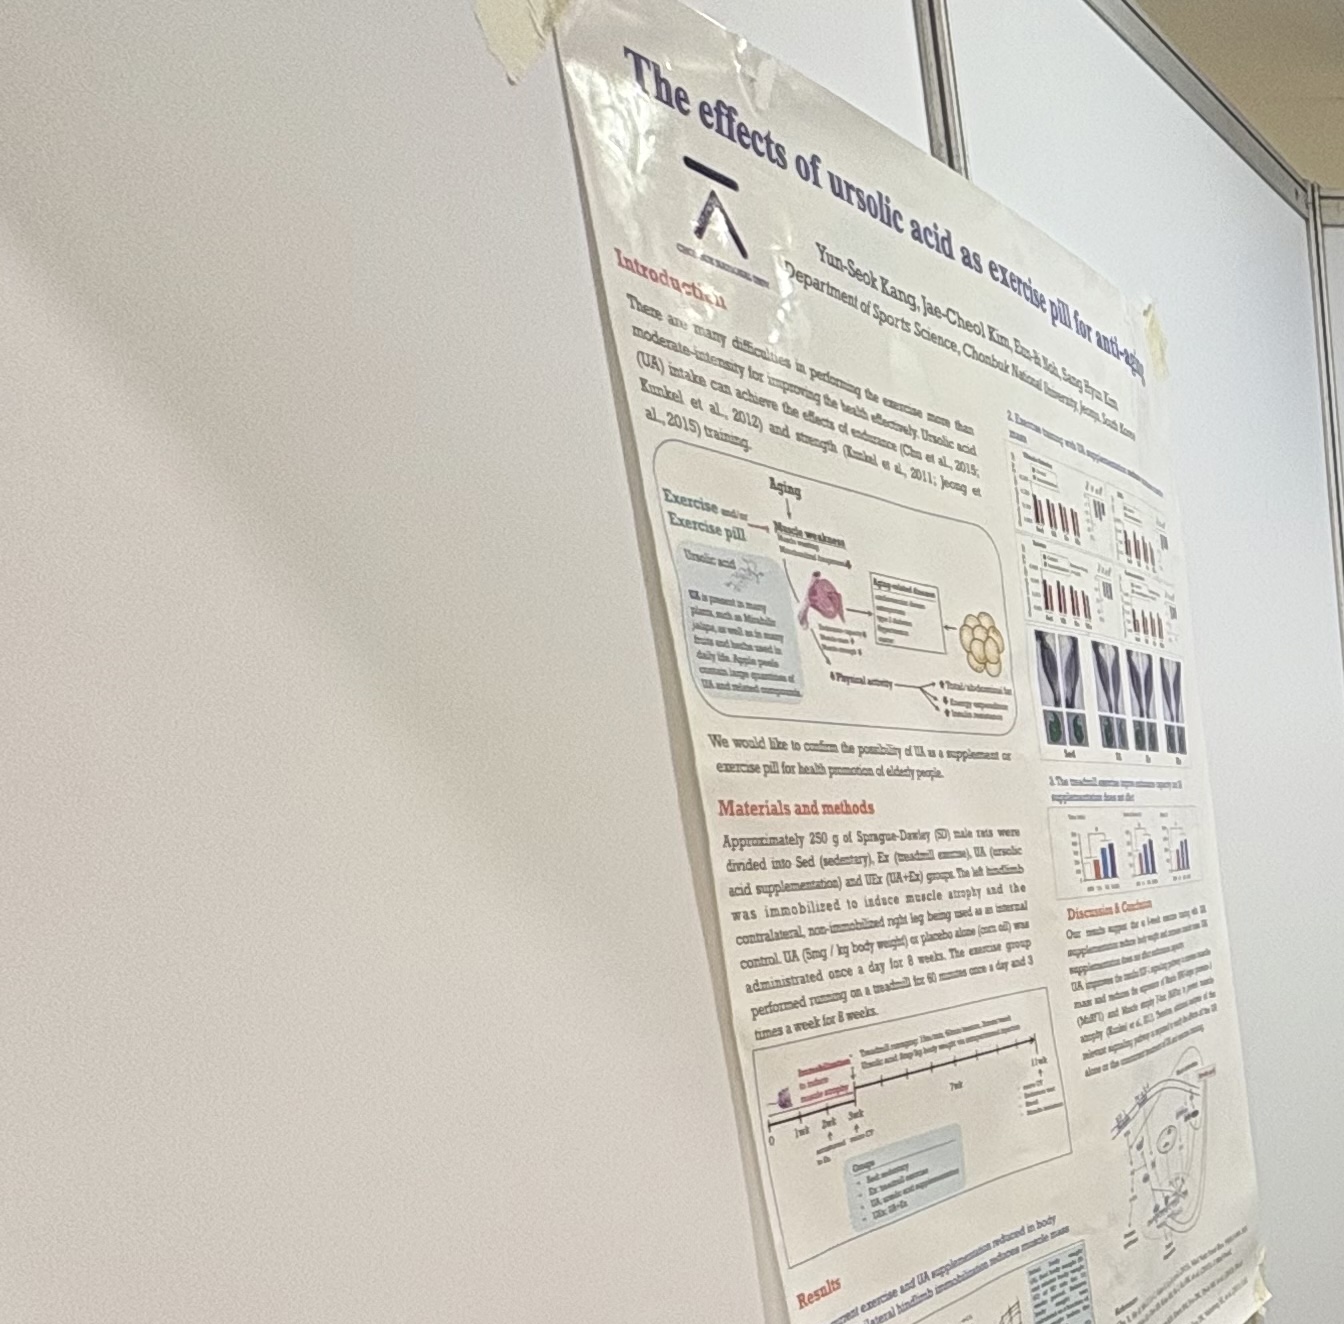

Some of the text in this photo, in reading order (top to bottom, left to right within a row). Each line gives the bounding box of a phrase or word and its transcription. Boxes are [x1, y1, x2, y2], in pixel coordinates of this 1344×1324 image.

[623, 45, 690, 116] The
[699, 99, 788, 170] effects
[795, 154, 823, 189] of
[827, 170, 904, 234] ursolic
[910, 219, 955, 260] acid
[960, 246, 983, 274] as
[988, 259, 1047, 313] exercise
[1049, 298, 1073, 327] pill
[1073, 312, 1093, 343] for
[815, 241, 878, 294] Yun-Seok
[921, 295, 984, 338] Jae-Cheol
[626, 293, 663, 321] There
[860, 302, 871, 315] of
[872, 303, 911, 333] Sports
[914, 322, 962, 356] Science,
[962, 343, 1010, 375] Chonbuk
[636, 350, 665, 376] (UA)
[710, 379, 732, 396] can
[782, 401, 799, 420] the
[666, 411, 702, 438] 2015)
[732, 407, 764, 433] 2012)
[769, 422, 791, 439] and
[662, 488, 719, 514] Exercise
[667, 511, 747, 542] Exercise pill
[707, 733, 801, 751] We would like to
[763, 761, 779, 778] pill
[781, 761, 796, 775] for
[718, 799, 876, 817] Materials and methods
[809, 831, 828, 845] 250
[731, 908, 757, 921] was
[796, 1276, 842, 1310] Results
